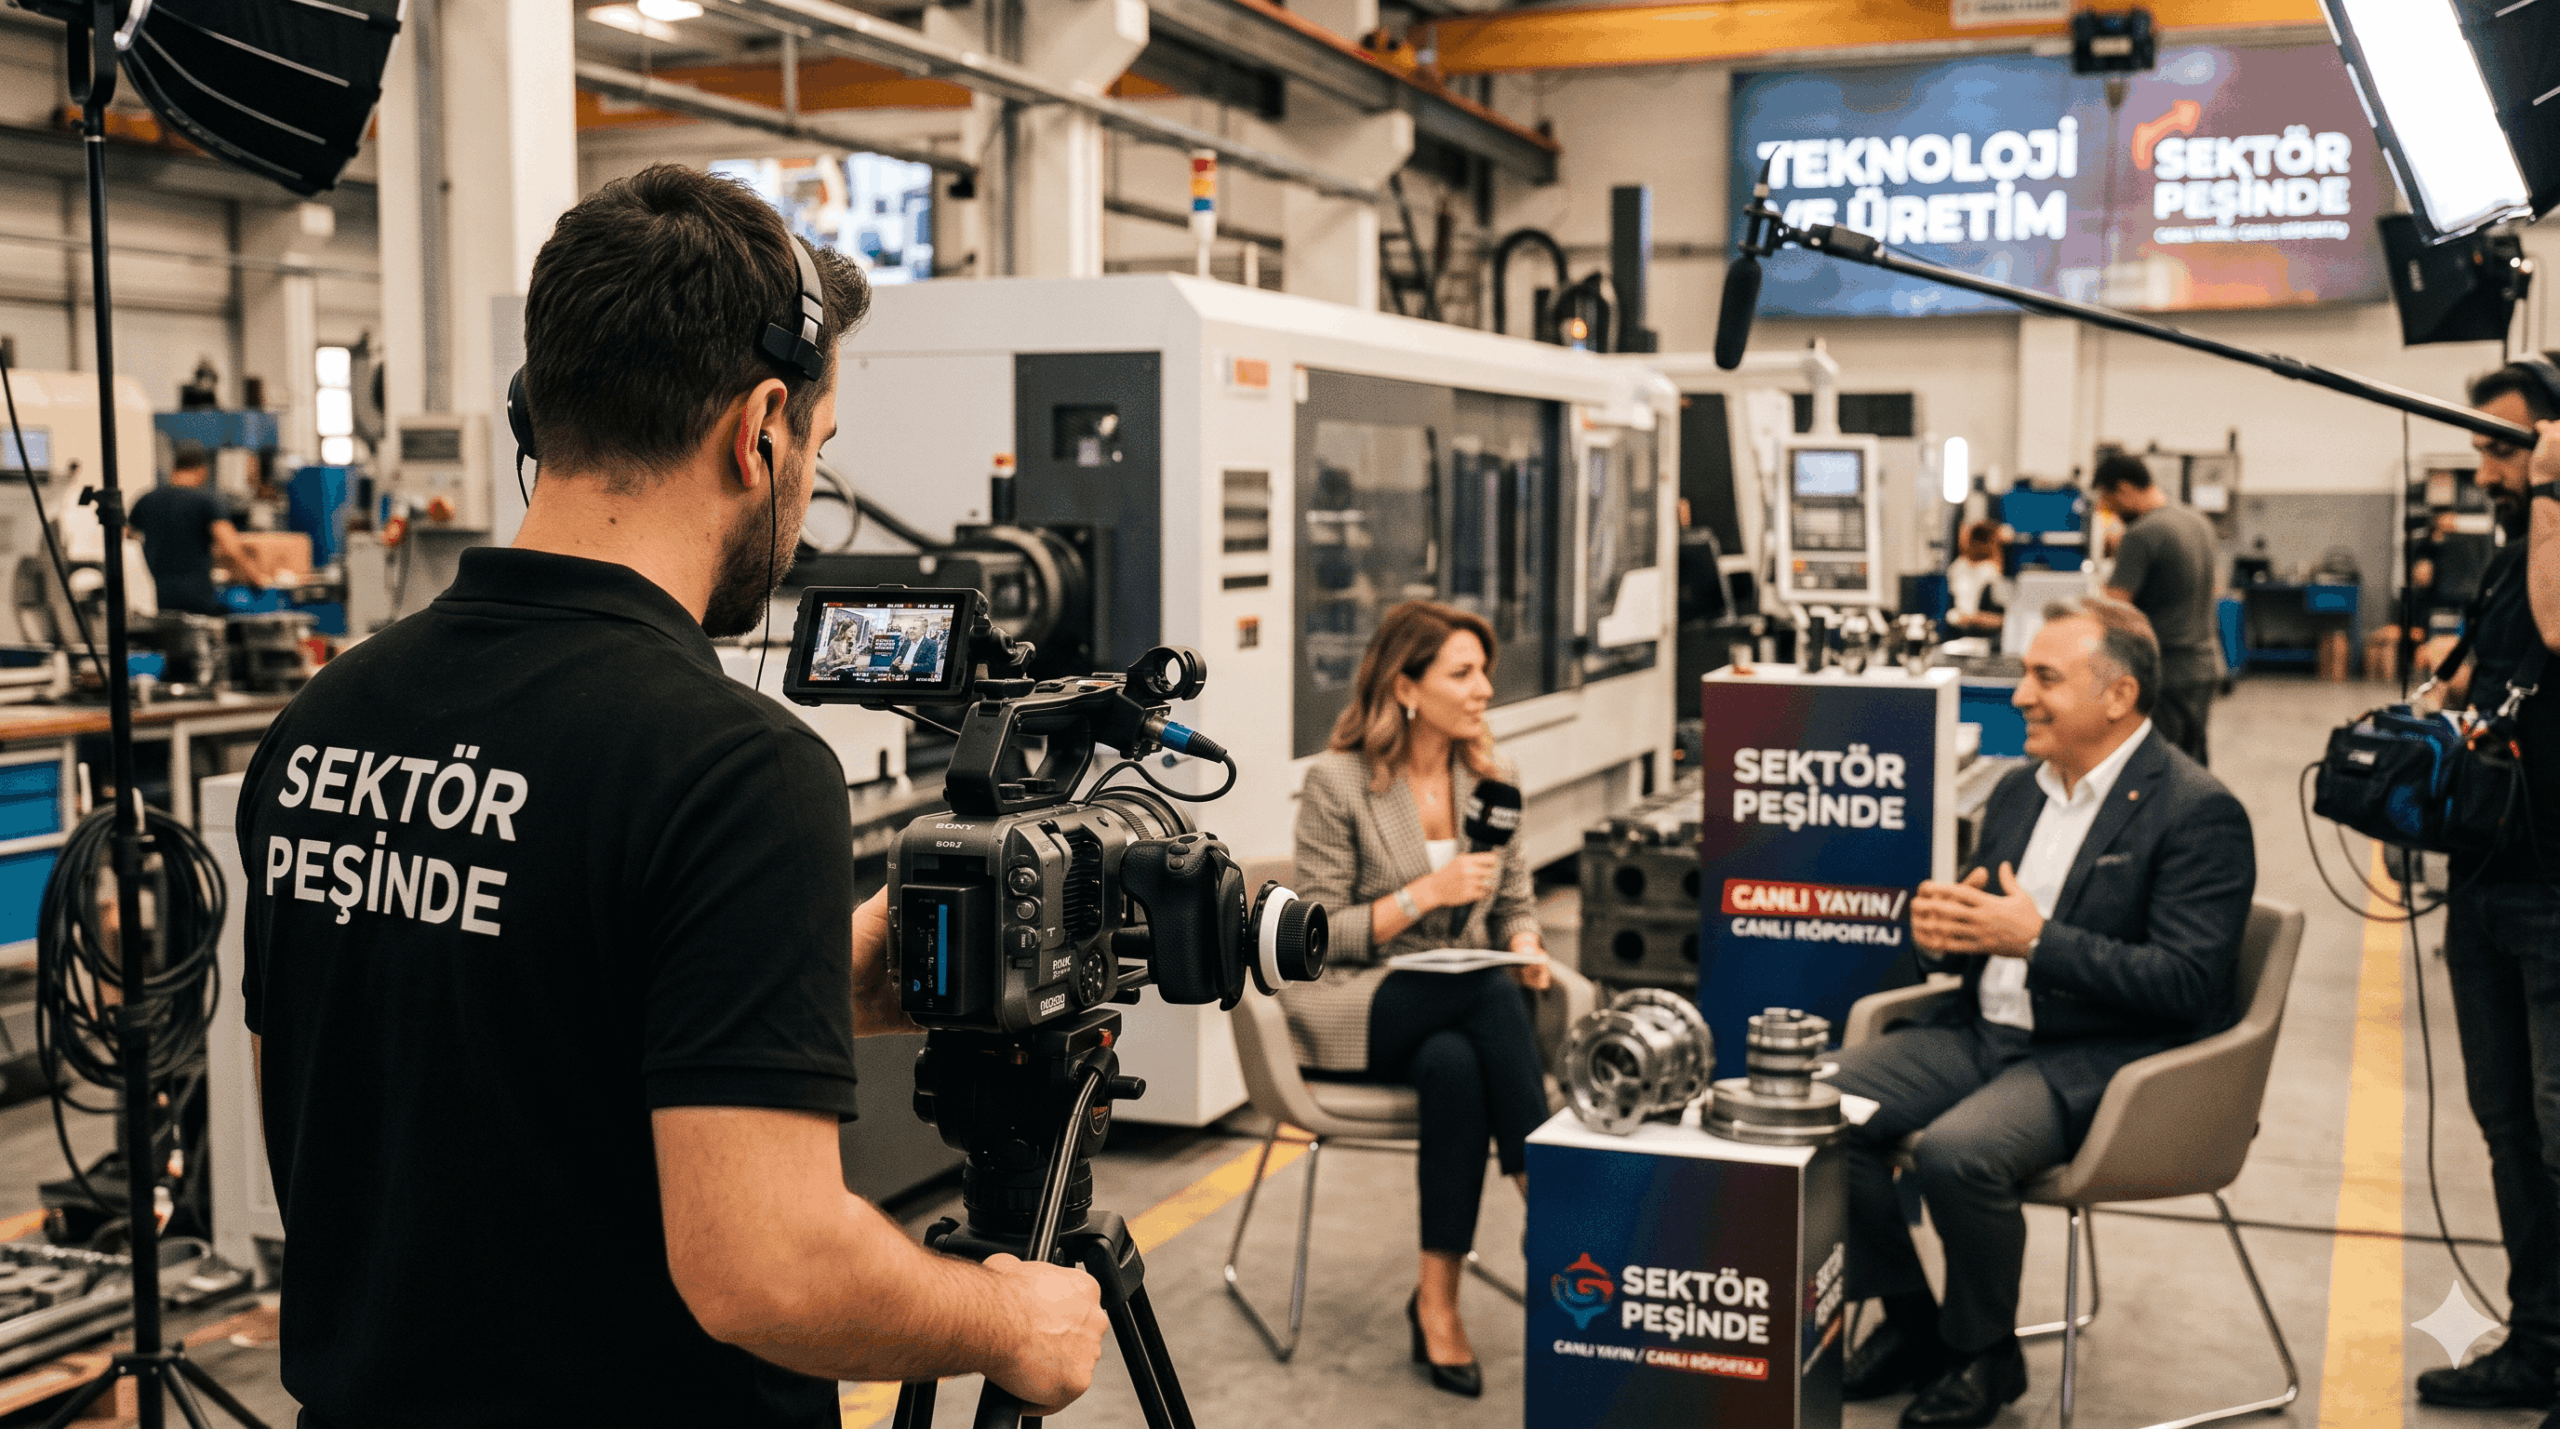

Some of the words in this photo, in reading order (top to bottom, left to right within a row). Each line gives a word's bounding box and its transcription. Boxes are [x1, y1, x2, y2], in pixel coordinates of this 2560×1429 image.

[1757, 116, 2078, 189] TEKNOLOJİ
[2155, 124, 2352, 180] SEKTÖR
[1847, 180, 2067, 244] ÜRETİM
[2154, 170, 2351, 226] PEŞİNDE
[278, 743, 528, 841] SEKTÖR
[1733, 743, 1906, 789] SEKTÖR
[1733, 784, 1906, 832] PEŞİNDE
[266, 830, 508, 936] PEŞİNDE
[1731, 884, 1811, 913] CANLI
[1731, 917, 1792, 939] CANLI
[1794, 919, 1902, 946] RÖPORTAJ
[1622, 1265, 1770, 1310] SEKTÖR
[1622, 1301, 1770, 1345] PEŞİNDE
